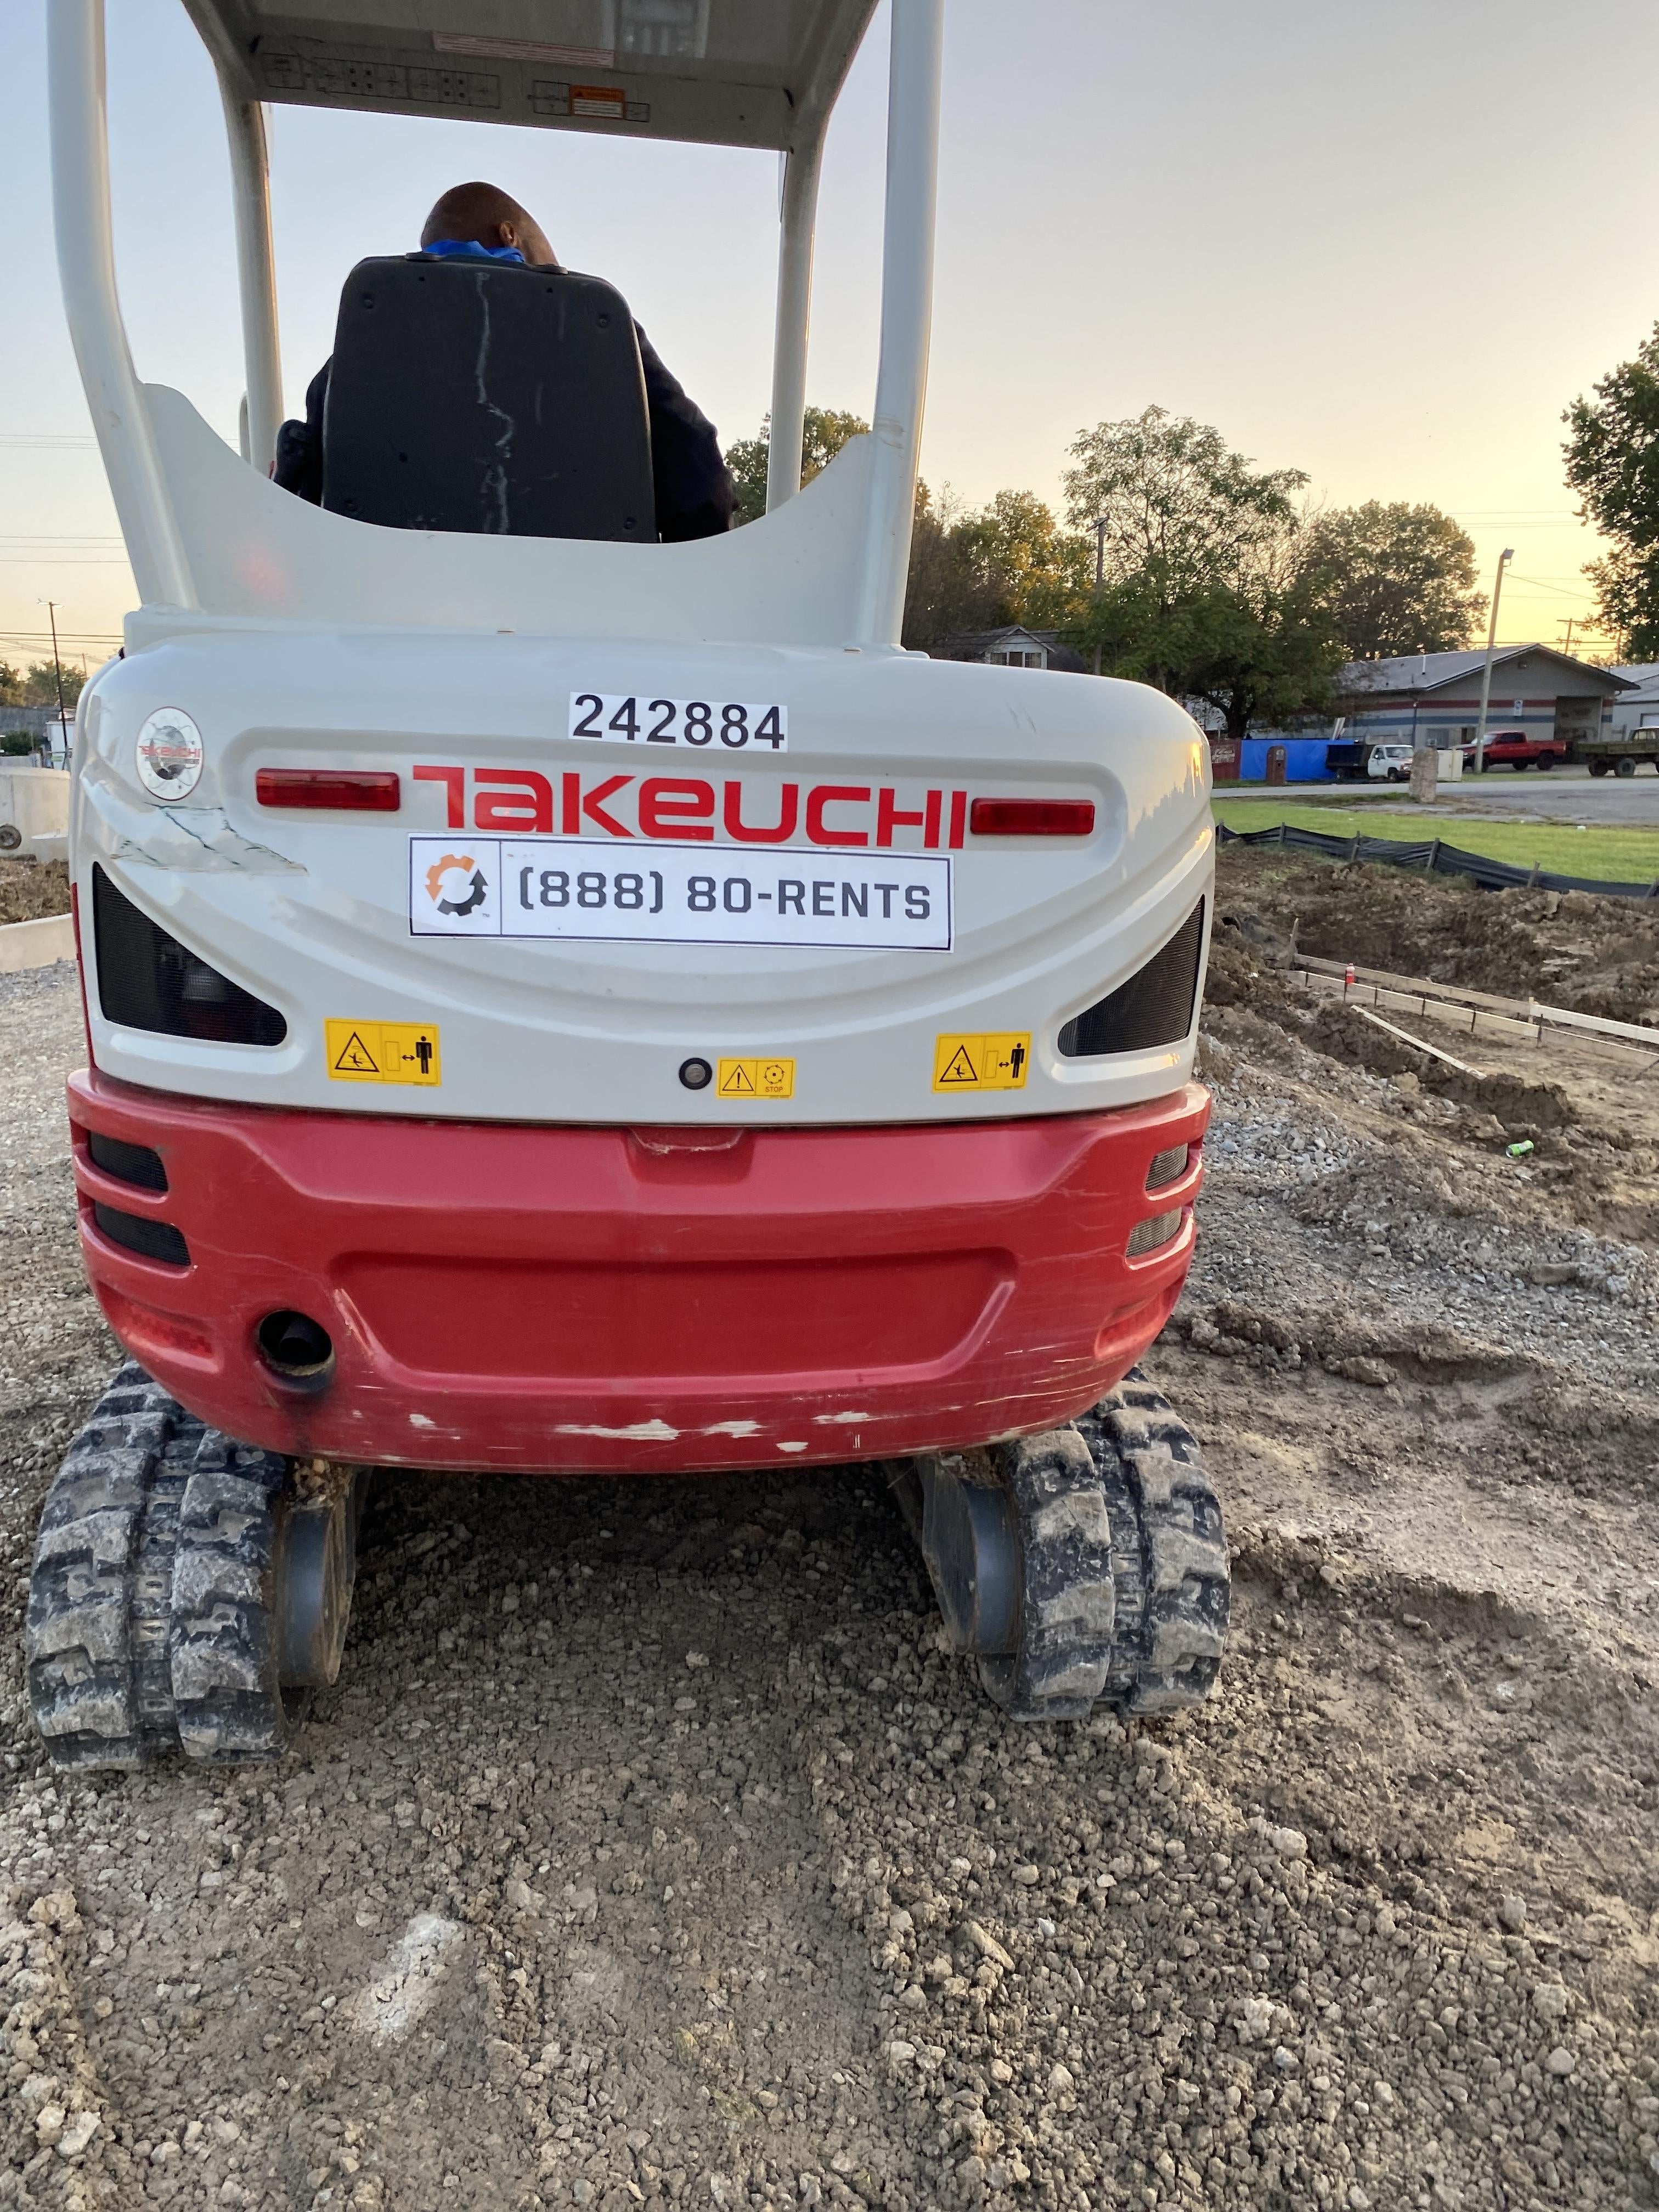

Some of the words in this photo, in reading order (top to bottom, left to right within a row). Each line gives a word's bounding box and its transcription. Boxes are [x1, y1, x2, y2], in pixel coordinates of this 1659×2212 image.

[573, 694, 785, 749] 242884
[520, 866, 663, 914] (888)
[687, 876, 930, 919] 80-RENTS
